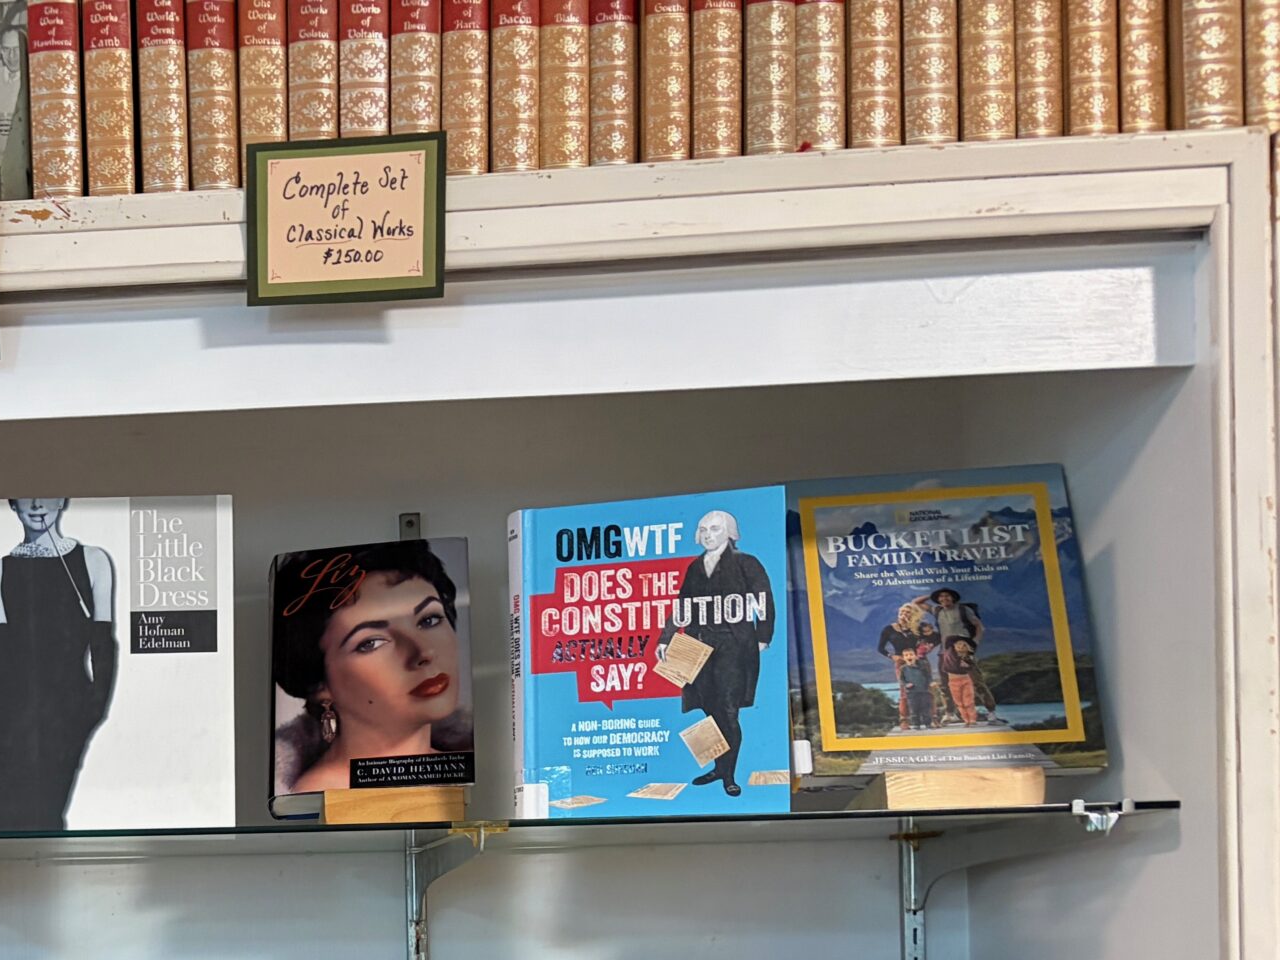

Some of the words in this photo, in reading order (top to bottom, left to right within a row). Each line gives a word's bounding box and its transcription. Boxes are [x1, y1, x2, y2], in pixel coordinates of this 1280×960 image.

[499, 15, 532, 25] Bacon
[90, 37, 120, 48] Lamb
[283, 172, 369, 208] Complete
[379, 166, 408, 190] Set
[332, 199, 349, 220] of
[286, 216, 363, 243] Classical
[372, 210, 414, 239] Works
[323, 248, 384, 265] $150.00
[132, 509, 182, 534] The
[136, 534, 203, 558] Little
[556, 522, 683, 562] OMGWTF
[826, 528, 952, 553] BUCKET
[960, 524, 1030, 545] LIST
[847, 552, 922, 568] FAMILY
[925, 545, 1014, 563] TRAVEL
[137, 558, 205, 583] Black
[138, 582, 208, 607] Dress
[563, 568, 633, 603] DOES
[639, 571, 680, 597] THE
[138, 613, 165, 624] Amy
[541, 592, 766, 636] CONSTITUTION
[139, 625, 185, 636] Holman
[139, 637, 190, 649] Edelman
[550, 635, 650, 663] ACTUALLY
[590, 662, 647, 692] SAY?
[578, 719, 636, 732] NON-BORING
[610, 731, 670, 745] DEMOCRACY
[372, 766, 405, 775] DAVID
[410, 762, 466, 773] HEYMANN
